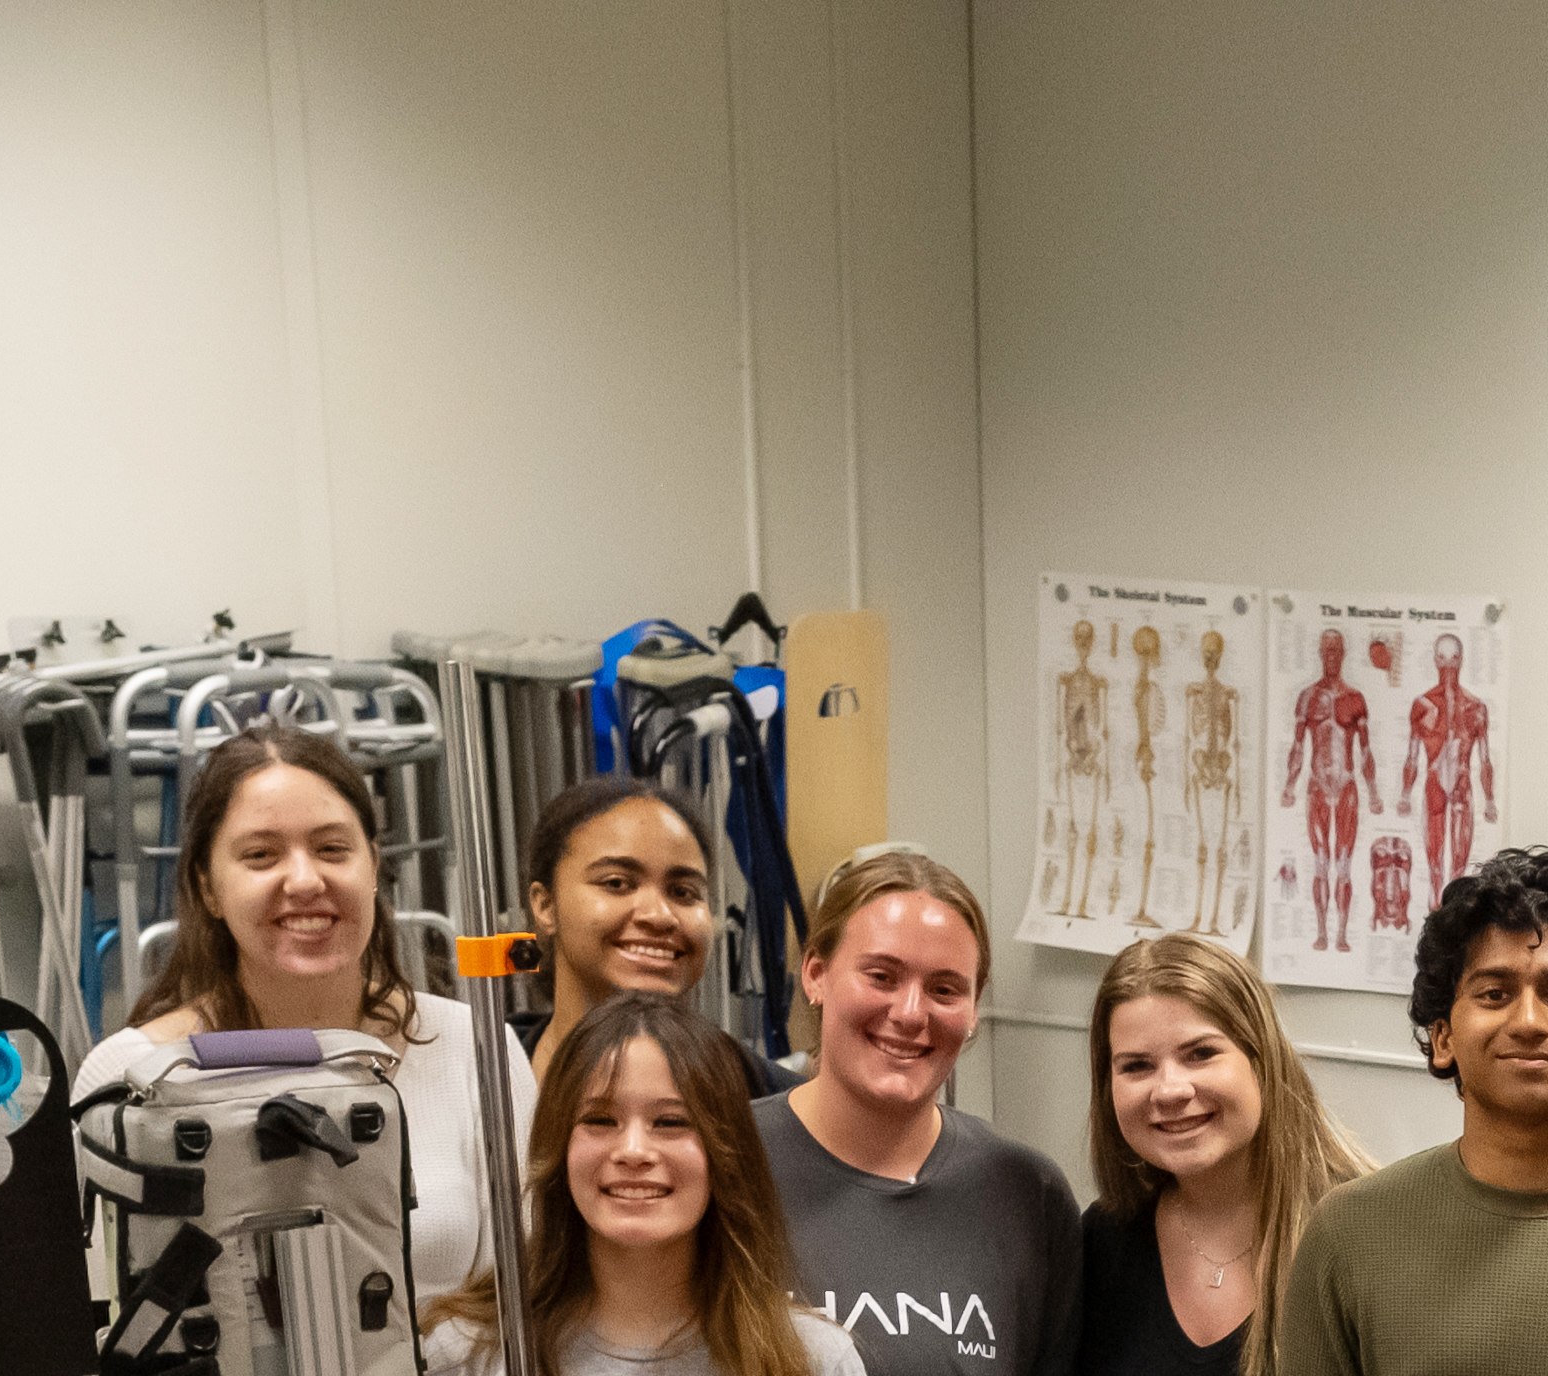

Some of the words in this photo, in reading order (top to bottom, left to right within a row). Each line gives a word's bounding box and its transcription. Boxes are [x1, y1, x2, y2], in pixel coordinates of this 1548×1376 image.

[1088, 585, 1109, 599] The
[1113, 587, 1160, 603] Skeletal
[1163, 591, 1207, 606] System
[1320, 604, 1342, 617] The
[1347, 606, 1403, 619] Muscular
[1408, 608, 1456, 622] System
[957, 1340, 996, 1359] MAUI
